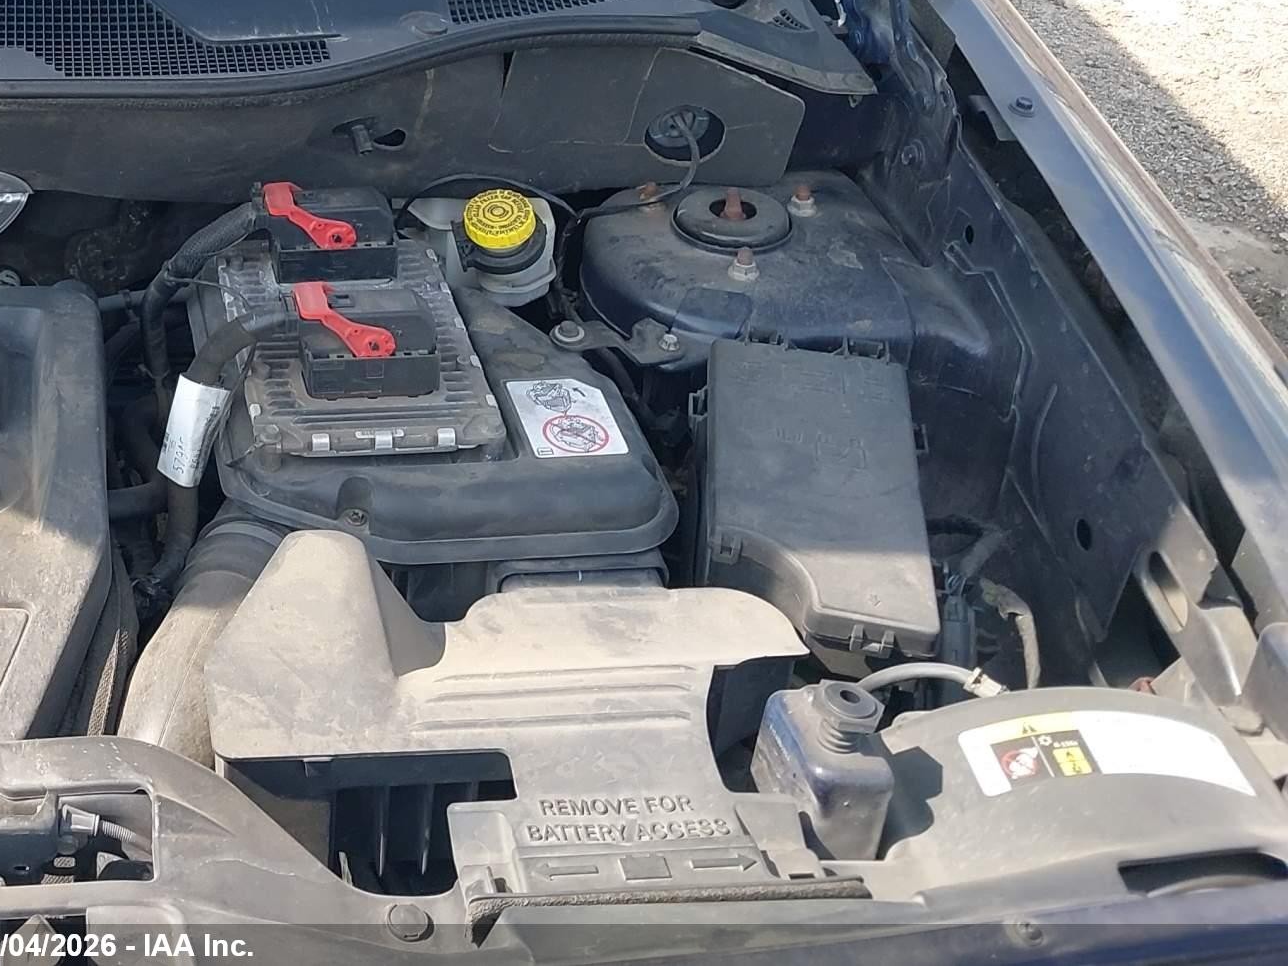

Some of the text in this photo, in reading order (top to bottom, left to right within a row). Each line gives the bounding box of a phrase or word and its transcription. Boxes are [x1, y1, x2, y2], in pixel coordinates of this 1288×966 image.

[538, 794, 695, 817] REMOVE FOR
[526, 818, 732, 843] BATTERY ACCESS
